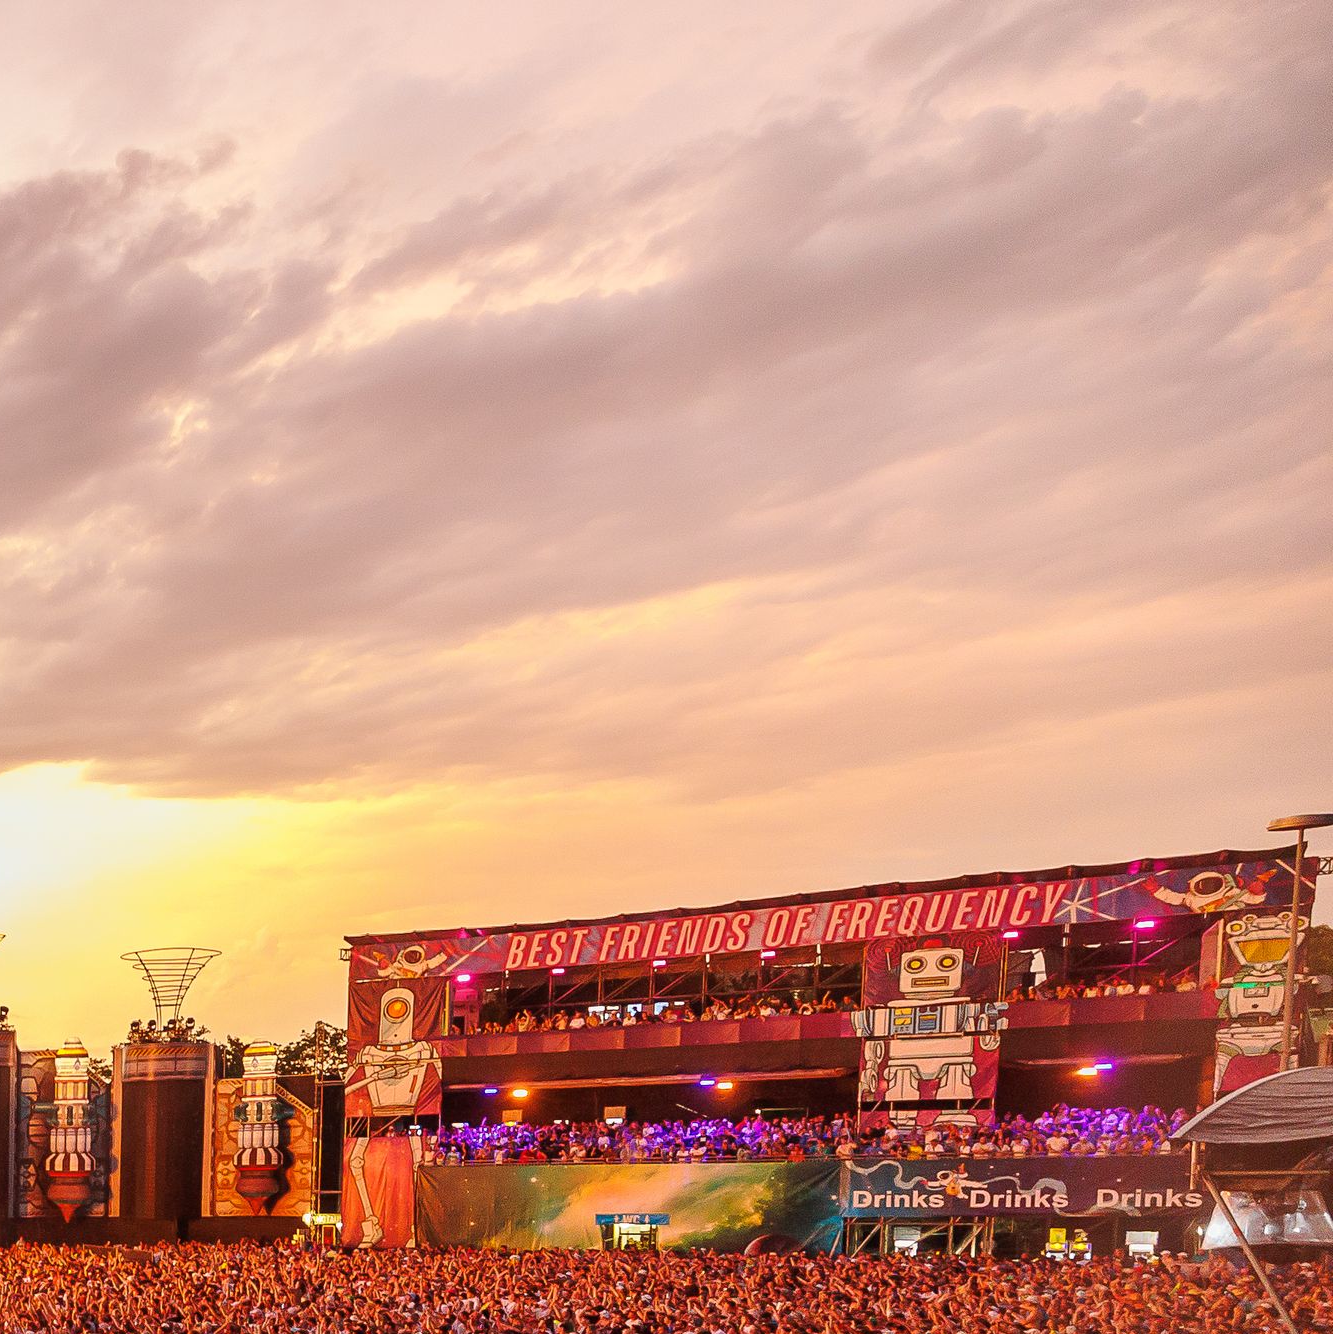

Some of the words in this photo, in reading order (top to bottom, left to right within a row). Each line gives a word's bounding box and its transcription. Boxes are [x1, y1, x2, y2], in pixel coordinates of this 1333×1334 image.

[506, 928, 589, 969] BEST
[599, 912, 751, 962] FRIENDS
[765, 907, 813, 947] OF
[825, 883, 1068, 941] FREQUENCY
[852, 1189, 945, 1208] Drinks
[970, 1189, 1069, 1208] Drinks
[1096, 1188, 1203, 1208] Drinks
